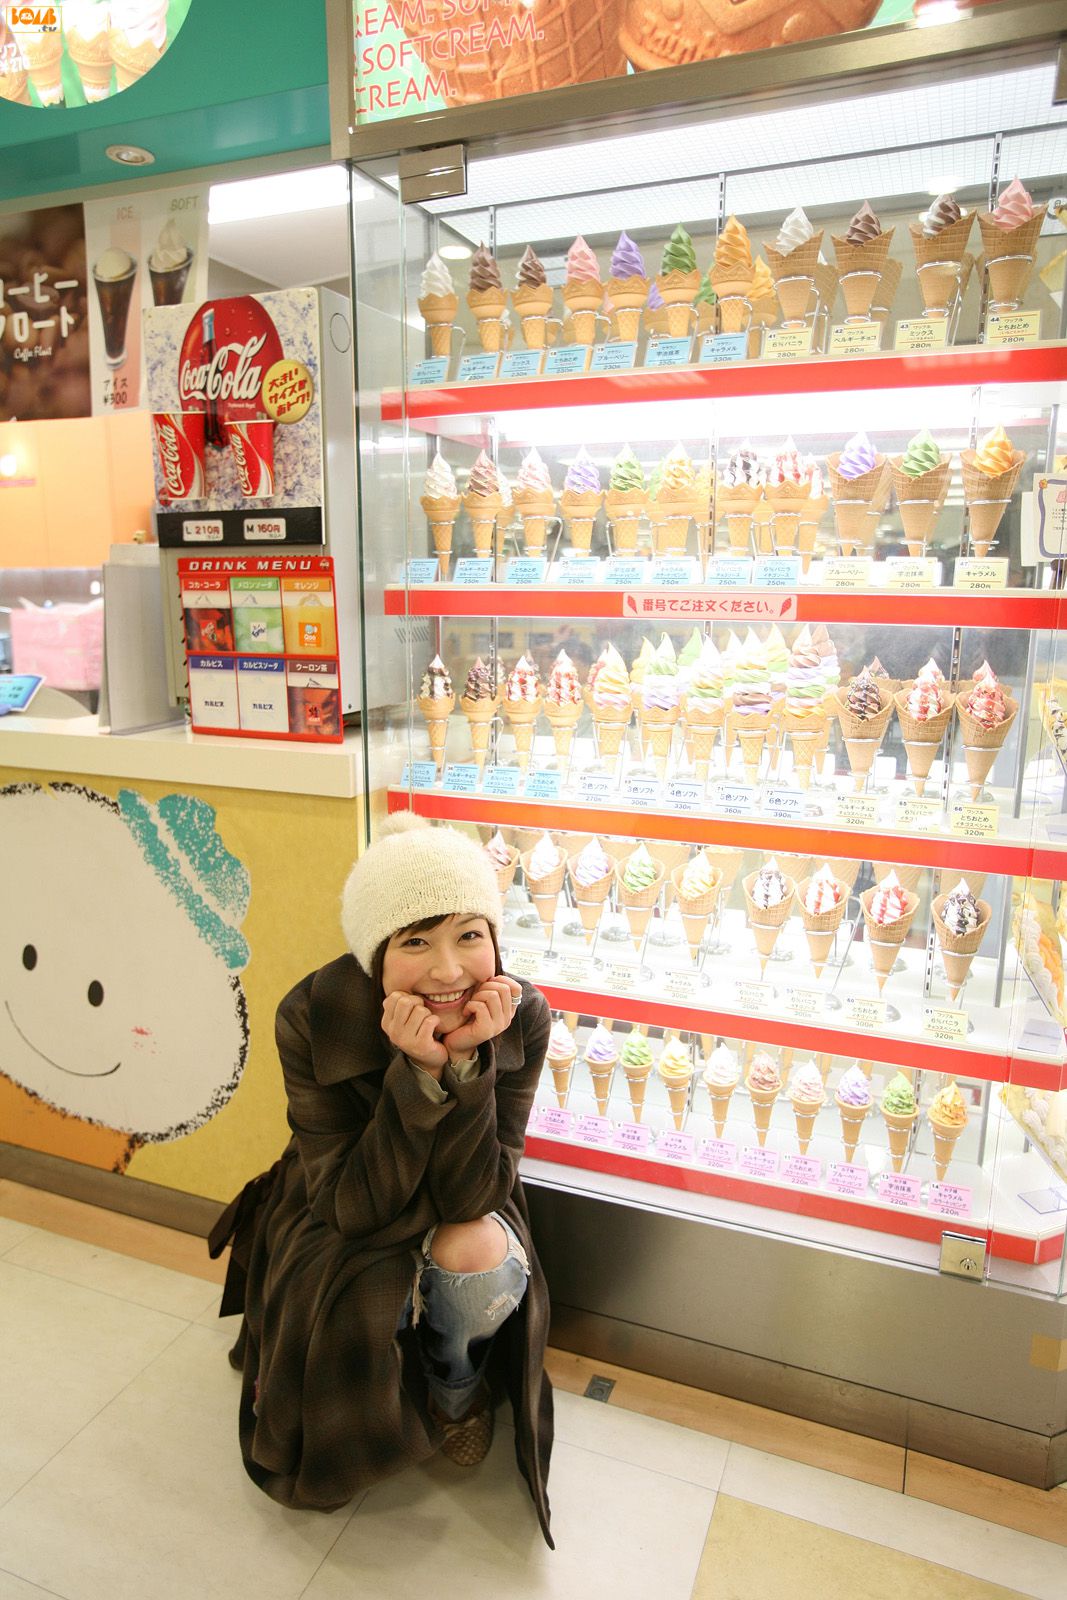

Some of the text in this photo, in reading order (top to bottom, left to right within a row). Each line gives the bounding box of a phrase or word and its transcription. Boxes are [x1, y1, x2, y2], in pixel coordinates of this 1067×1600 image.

[362, 13, 545, 76] SOFTCREAM.
[171, 195, 200, 212] SOFT
[116, 206, 134, 220] ICE
[0, 272, 79, 309] ーヒー
[997, 322, 1030, 331] とちおとめ
[180, 331, 268, 401] Coca-Cola
[268, 367, 300, 393] 大きい
[185, 525, 220, 535] L 210円
[246, 523, 281, 533] M 160円
[188, 560, 248, 571] DRINK
[256, 559, 312, 571] MENU
[642, 598, 774, 613] 番号でご注文ください。
[243, 661, 279, 670] カルピスソーダ
[296, 663, 328, 672] ウーロン茶
[581, 782, 609, 790] 2色ソフト
[627, 785, 656, 794] 3色ソフト
[669, 789, 699, 798] 4色ソフト
[719, 793, 750, 802] 5色ソフト
[768, 797, 800, 806] 6色ソフト
[846, 817, 865, 825] 320円
[960, 815, 990, 823] とちおとめ
[964, 829, 985, 837] 320円
[934, 1032, 954, 1041] 320円
[666, 1152, 683, 1160] 200円
[749, 1169, 766, 1177] 220円
[791, 1177, 808, 1186] 220円
[837, 1187, 855, 1195] 220円
[890, 1197, 908, 1206] 220円
[938, 1192, 963, 1202] キャラメル
[940, 1207, 959, 1216] 220円
